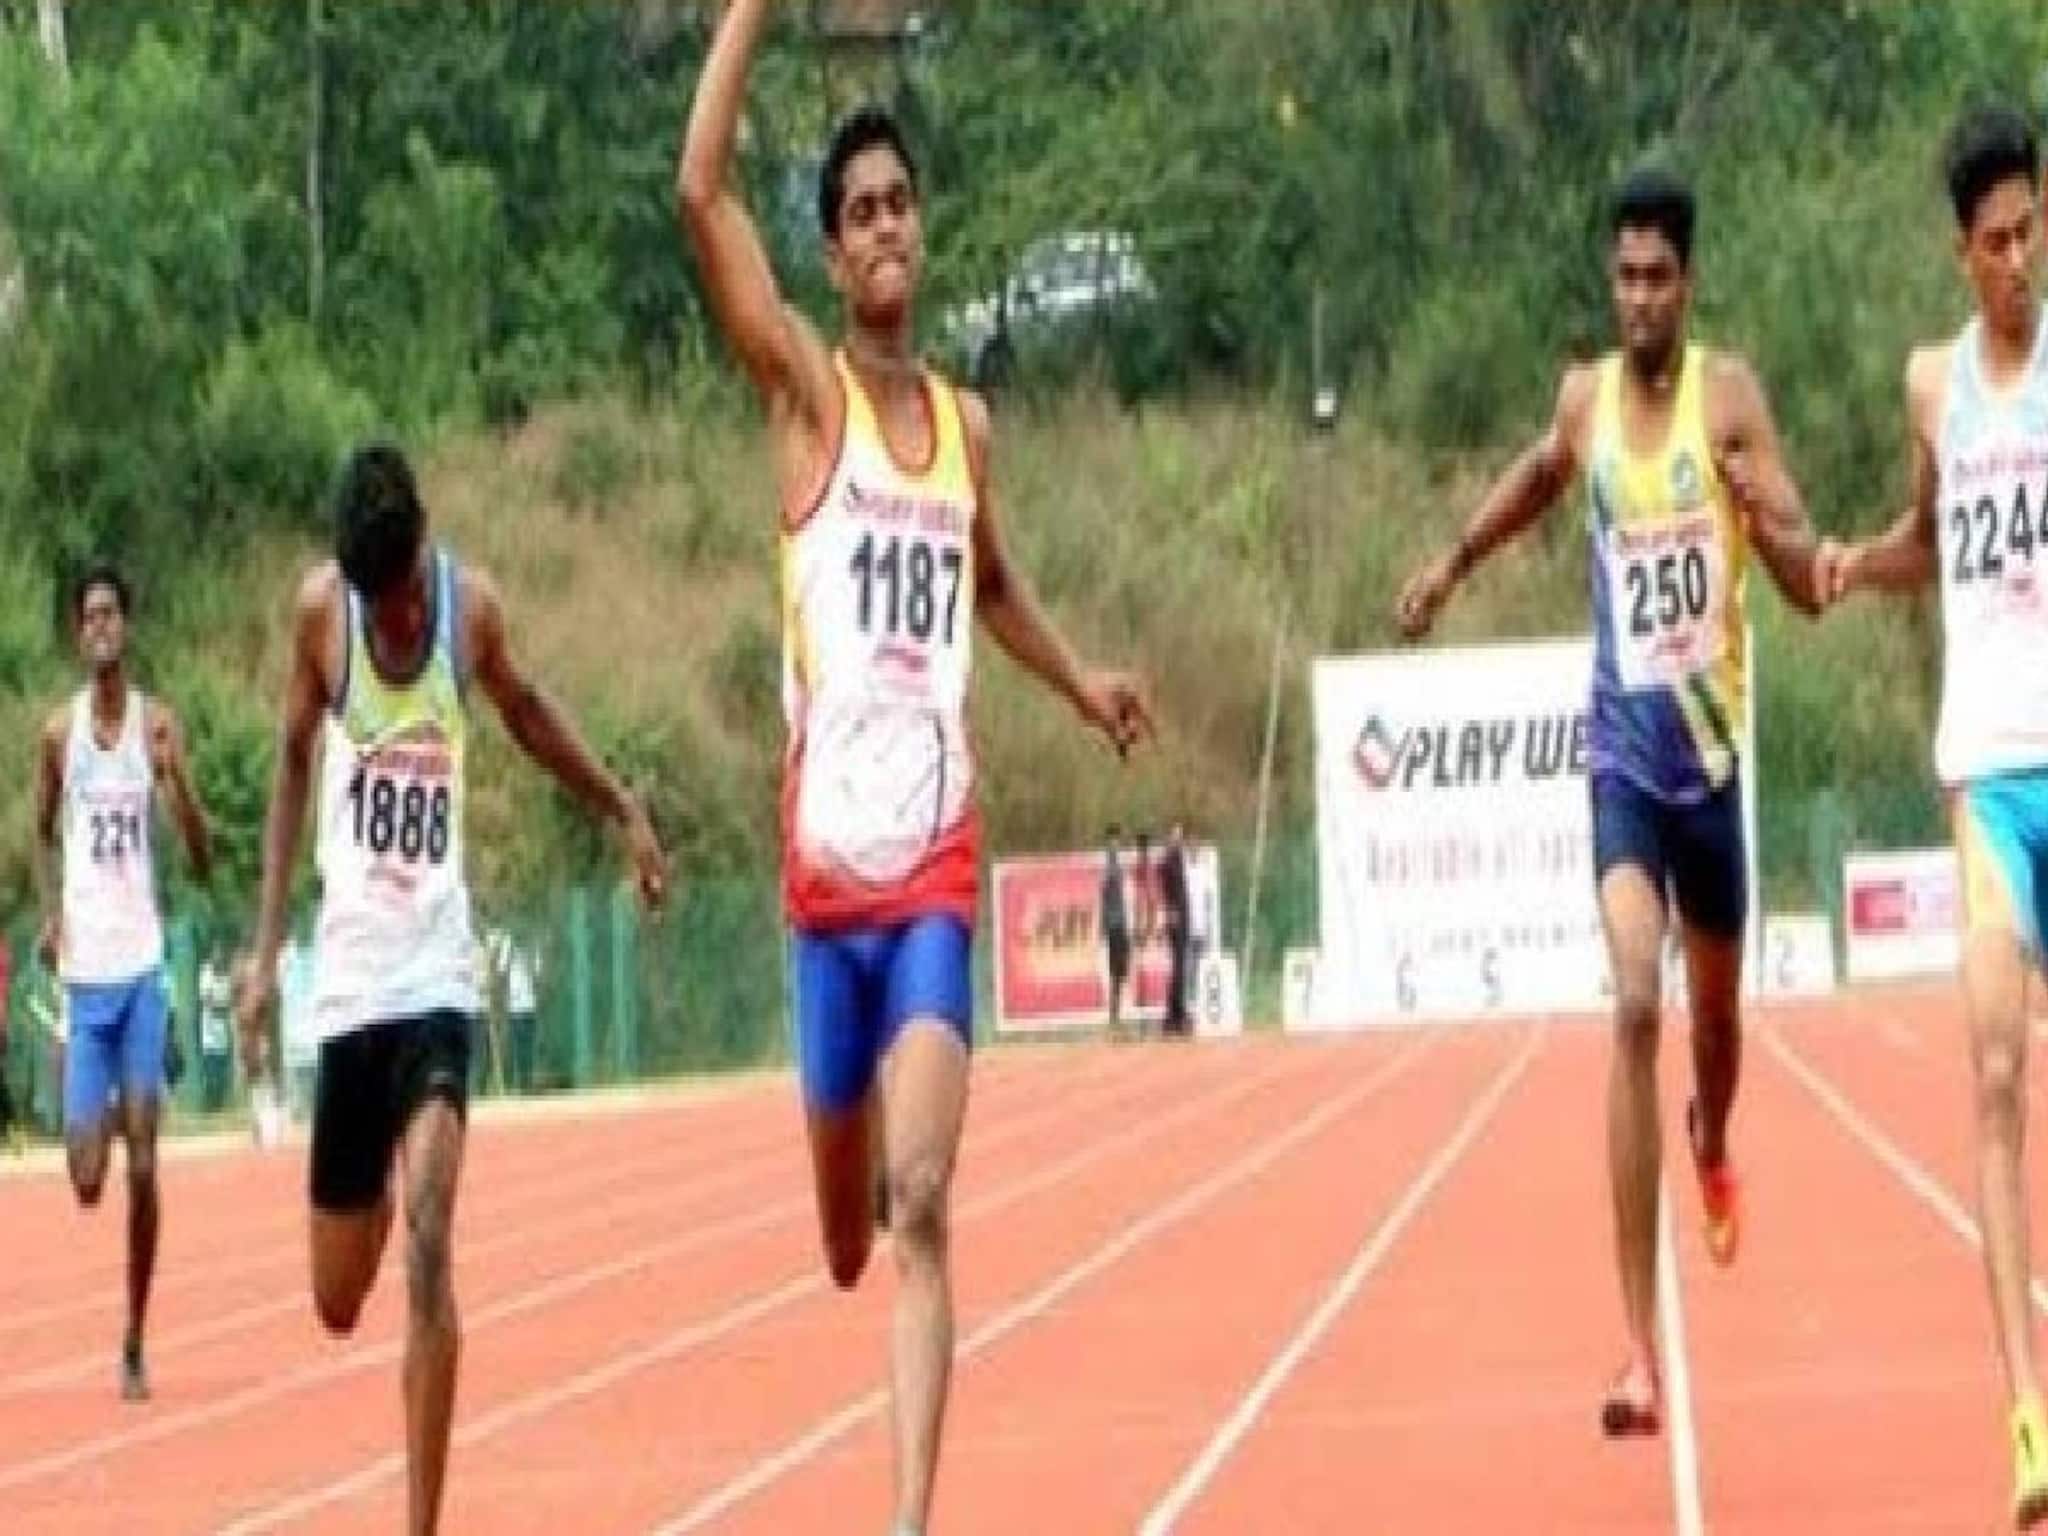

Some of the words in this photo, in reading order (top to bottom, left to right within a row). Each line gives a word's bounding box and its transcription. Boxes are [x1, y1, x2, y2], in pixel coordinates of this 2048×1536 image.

[850, 530, 963, 648] 1187
[1625, 548, 1708, 637] 250
[1402, 717, 1516, 790] PLAY
[348, 767, 449, 864] 1888
